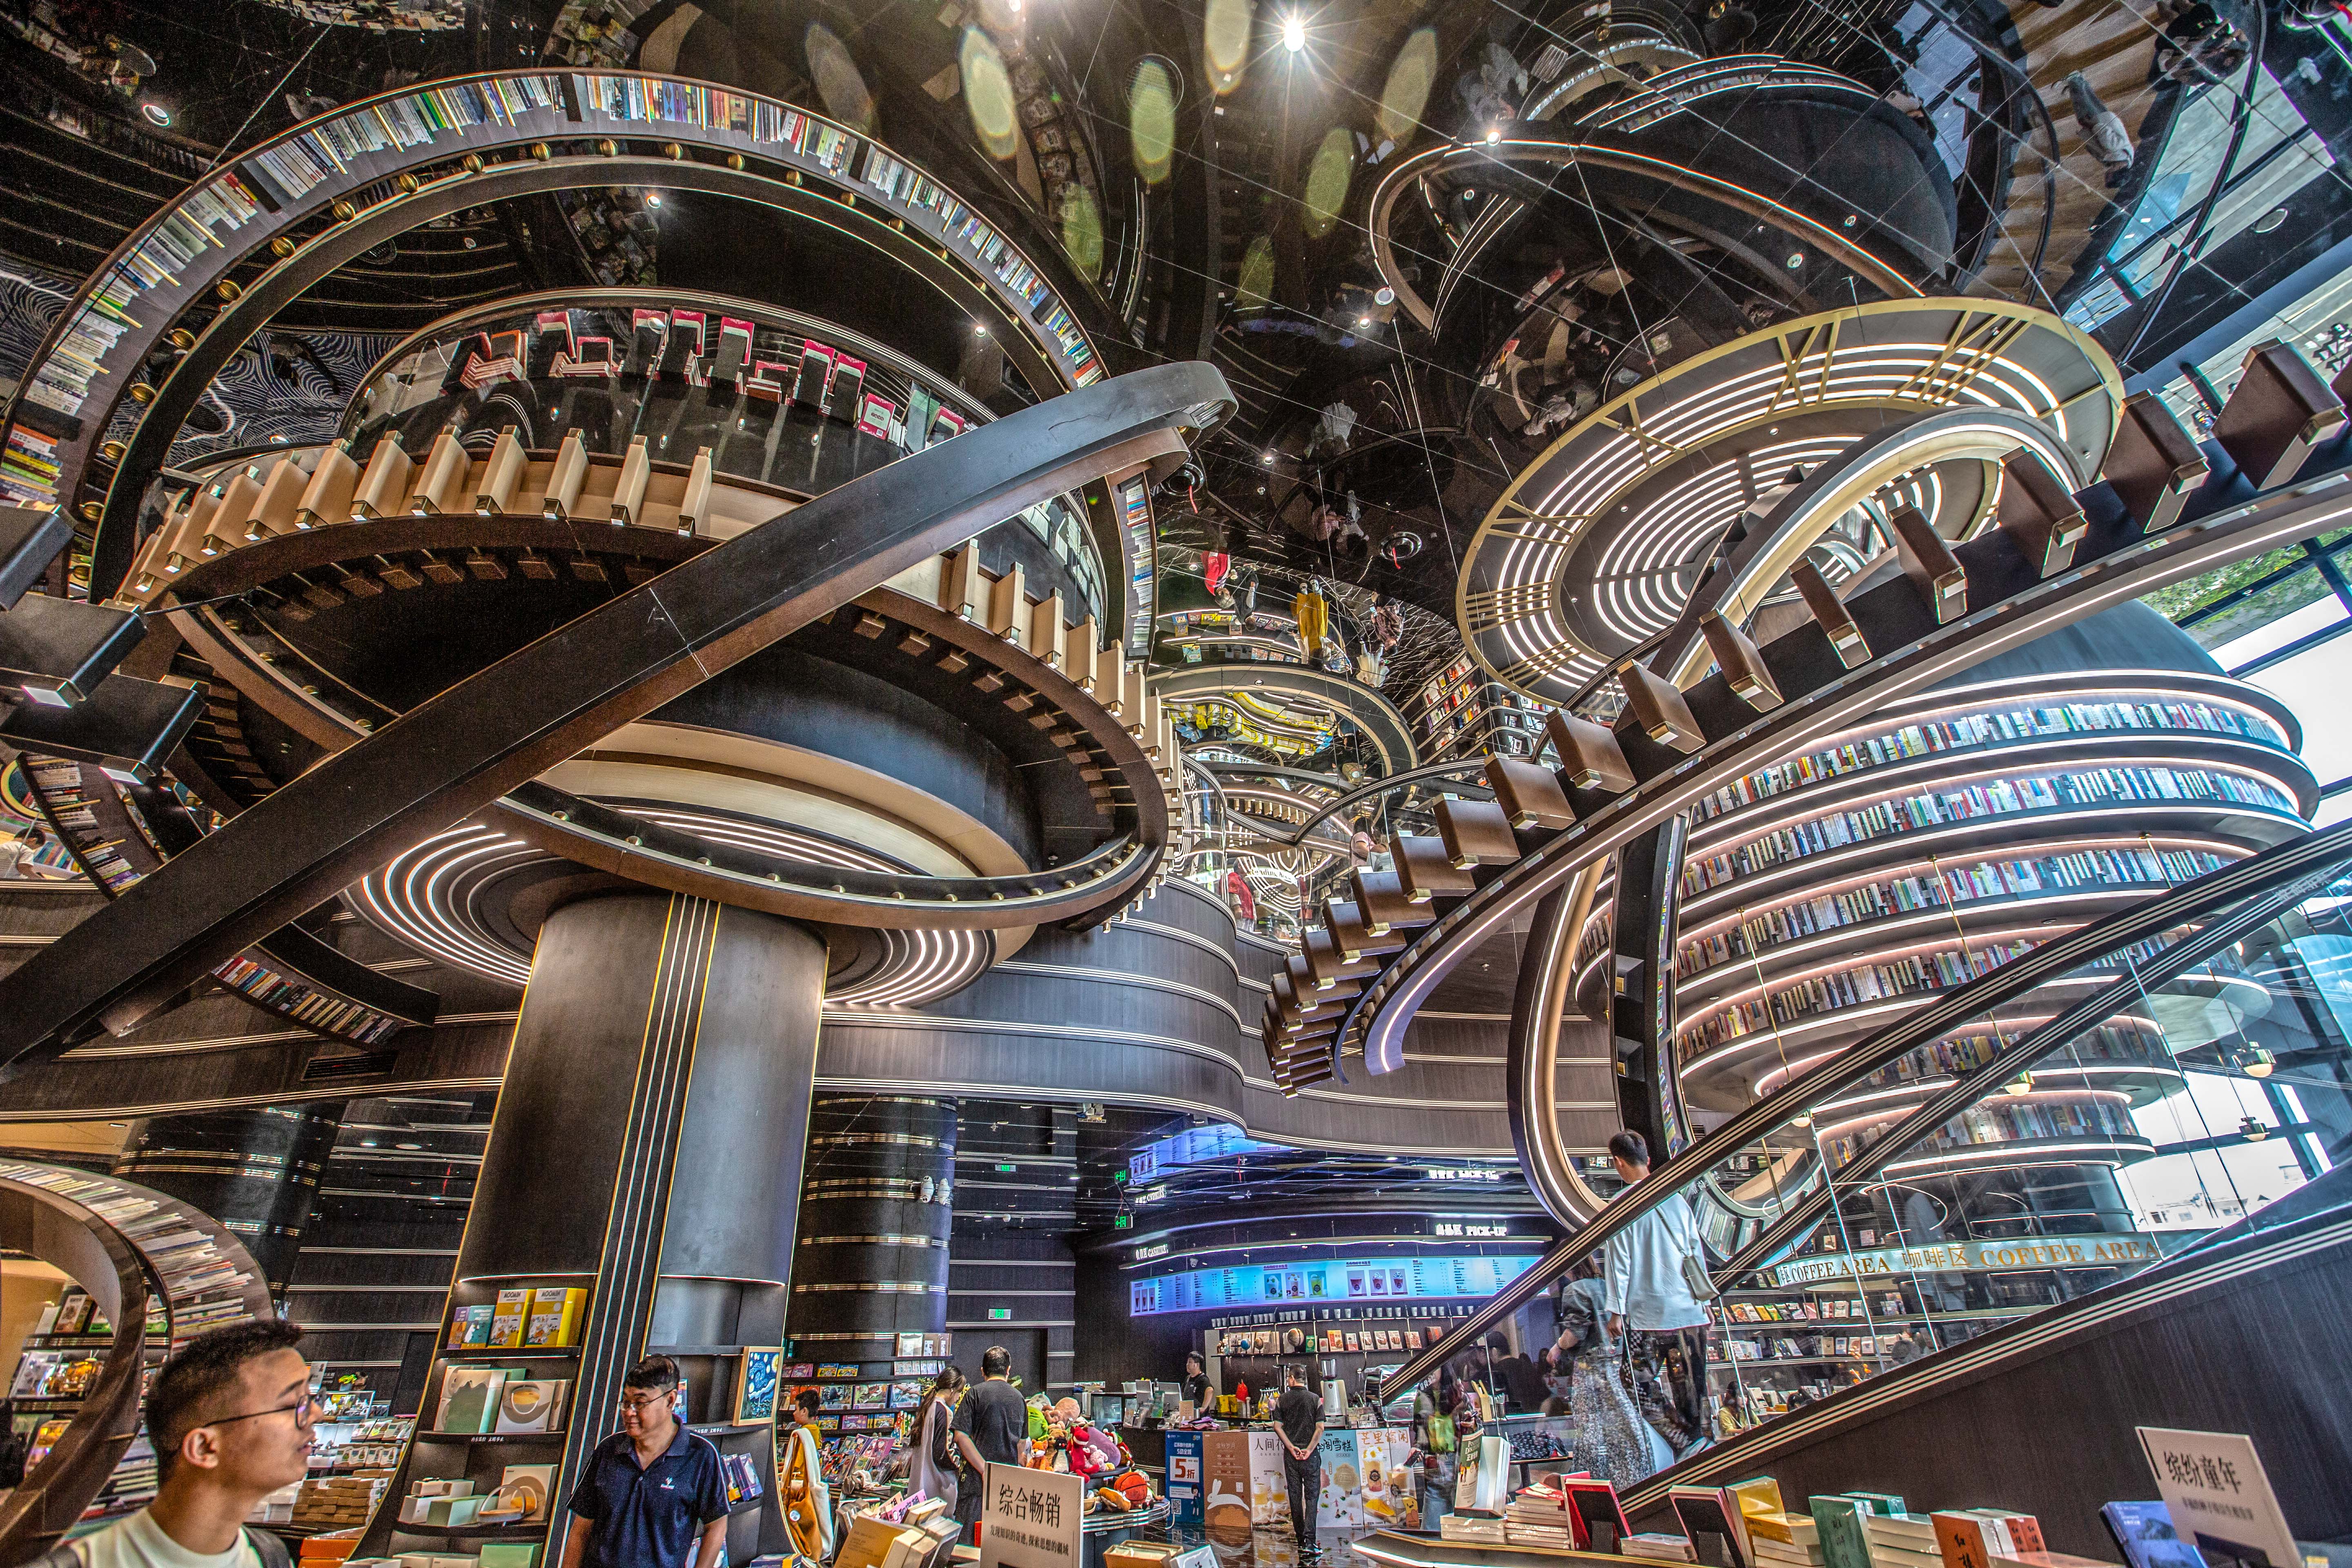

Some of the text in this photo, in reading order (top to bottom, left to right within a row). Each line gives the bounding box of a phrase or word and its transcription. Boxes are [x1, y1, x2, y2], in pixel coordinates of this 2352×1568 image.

[1466, 1226, 1507, 1236] PICK-UP
[1902, 1241, 2160, 1270] 咖啡区 COFFEE AREA
[1792, 1262, 1836, 1282] COFFEE
[1841, 1257, 1891, 1276] AREA
[1175, 1458, 1195, 1479] 5折
[2163, 1450, 2242, 1494] 缤纷童年
[999, 1483, 1061, 1528] 综合畅销
